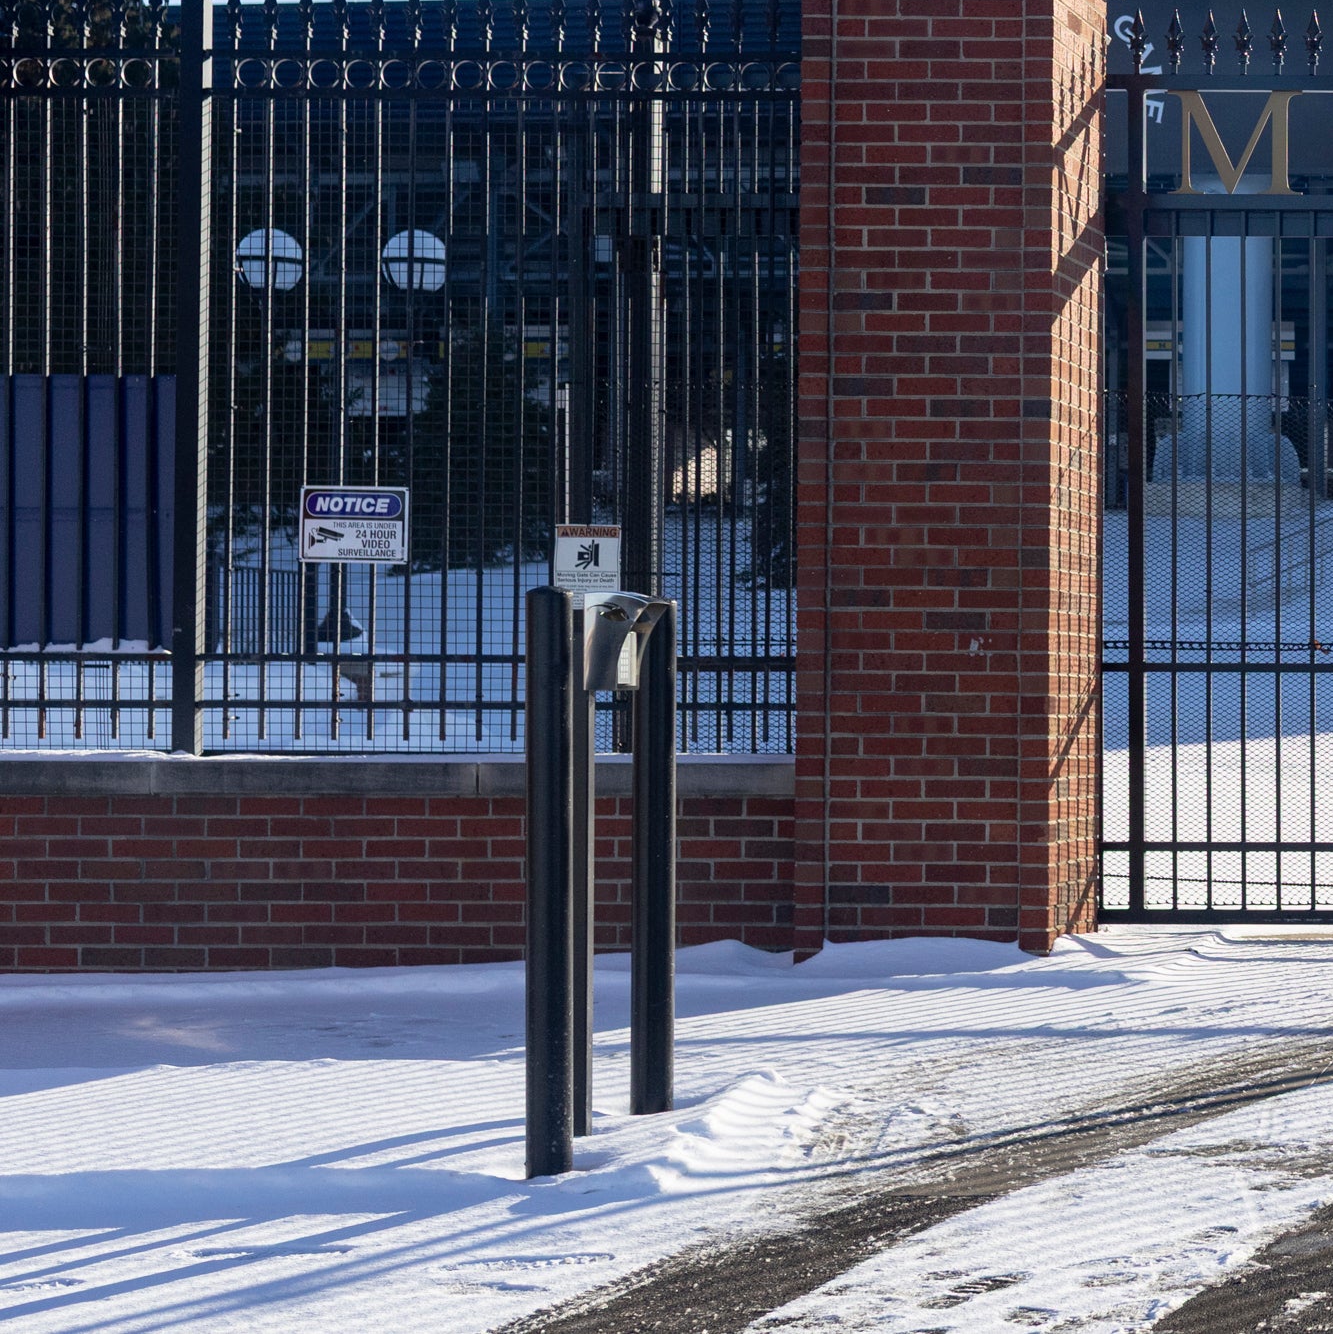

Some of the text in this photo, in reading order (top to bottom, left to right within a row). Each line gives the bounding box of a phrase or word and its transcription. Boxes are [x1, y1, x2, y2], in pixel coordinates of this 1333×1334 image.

[315, 496, 390, 513] NOTICE
[355, 530, 397, 540] 24 HOUR
[569, 527, 617, 538] WARNING
[361, 539, 391, 549] VIDEO
[337, 548, 397, 558] SURVEILLANCE
